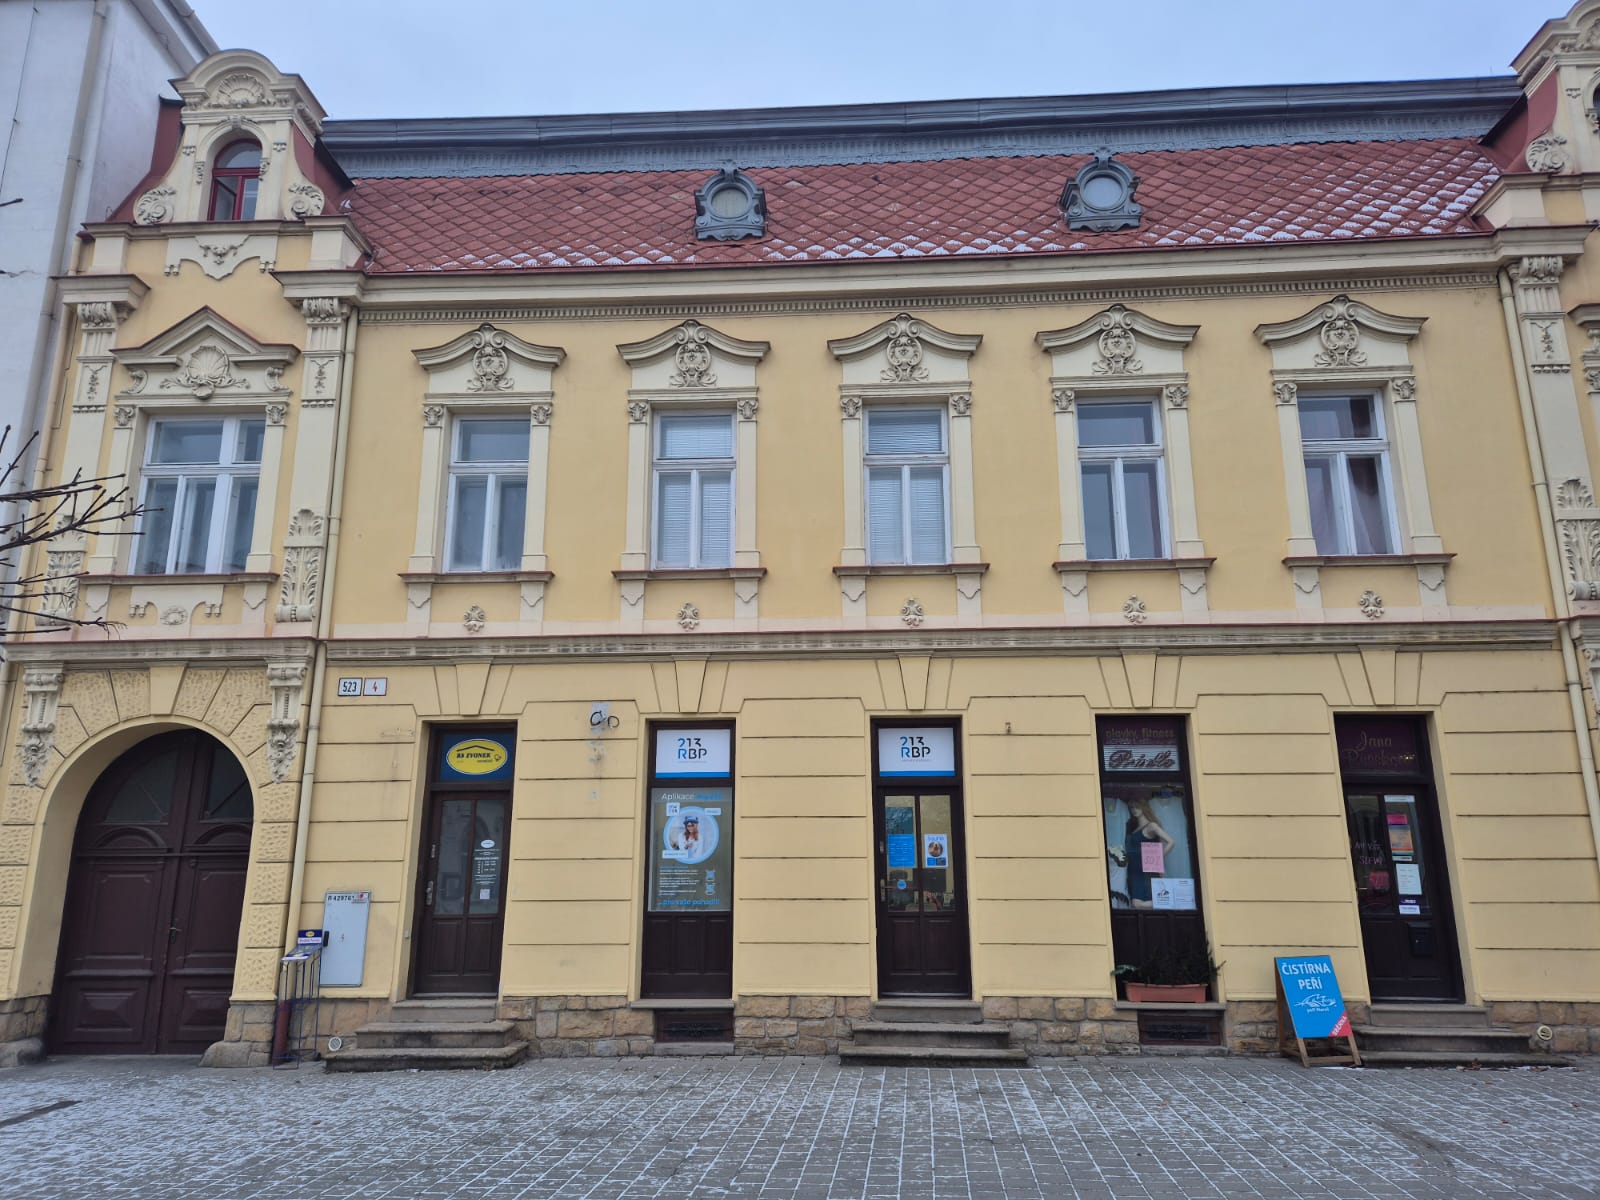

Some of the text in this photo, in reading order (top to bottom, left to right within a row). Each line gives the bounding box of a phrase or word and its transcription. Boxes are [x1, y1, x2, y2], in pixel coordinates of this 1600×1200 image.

[342, 681, 357, 693] 523
[372, 681, 378, 692] 4
[677, 738, 702, 747] 213
[900, 736, 925, 746] 213
[678, 748, 707, 759] RBP
[901, 746, 931, 758] RBP
[661, 792, 695, 801] Aplikace
[1281, 962, 1332, 975] ČISTÍRNA
[1298, 976, 1323, 990] PEŘÍ
